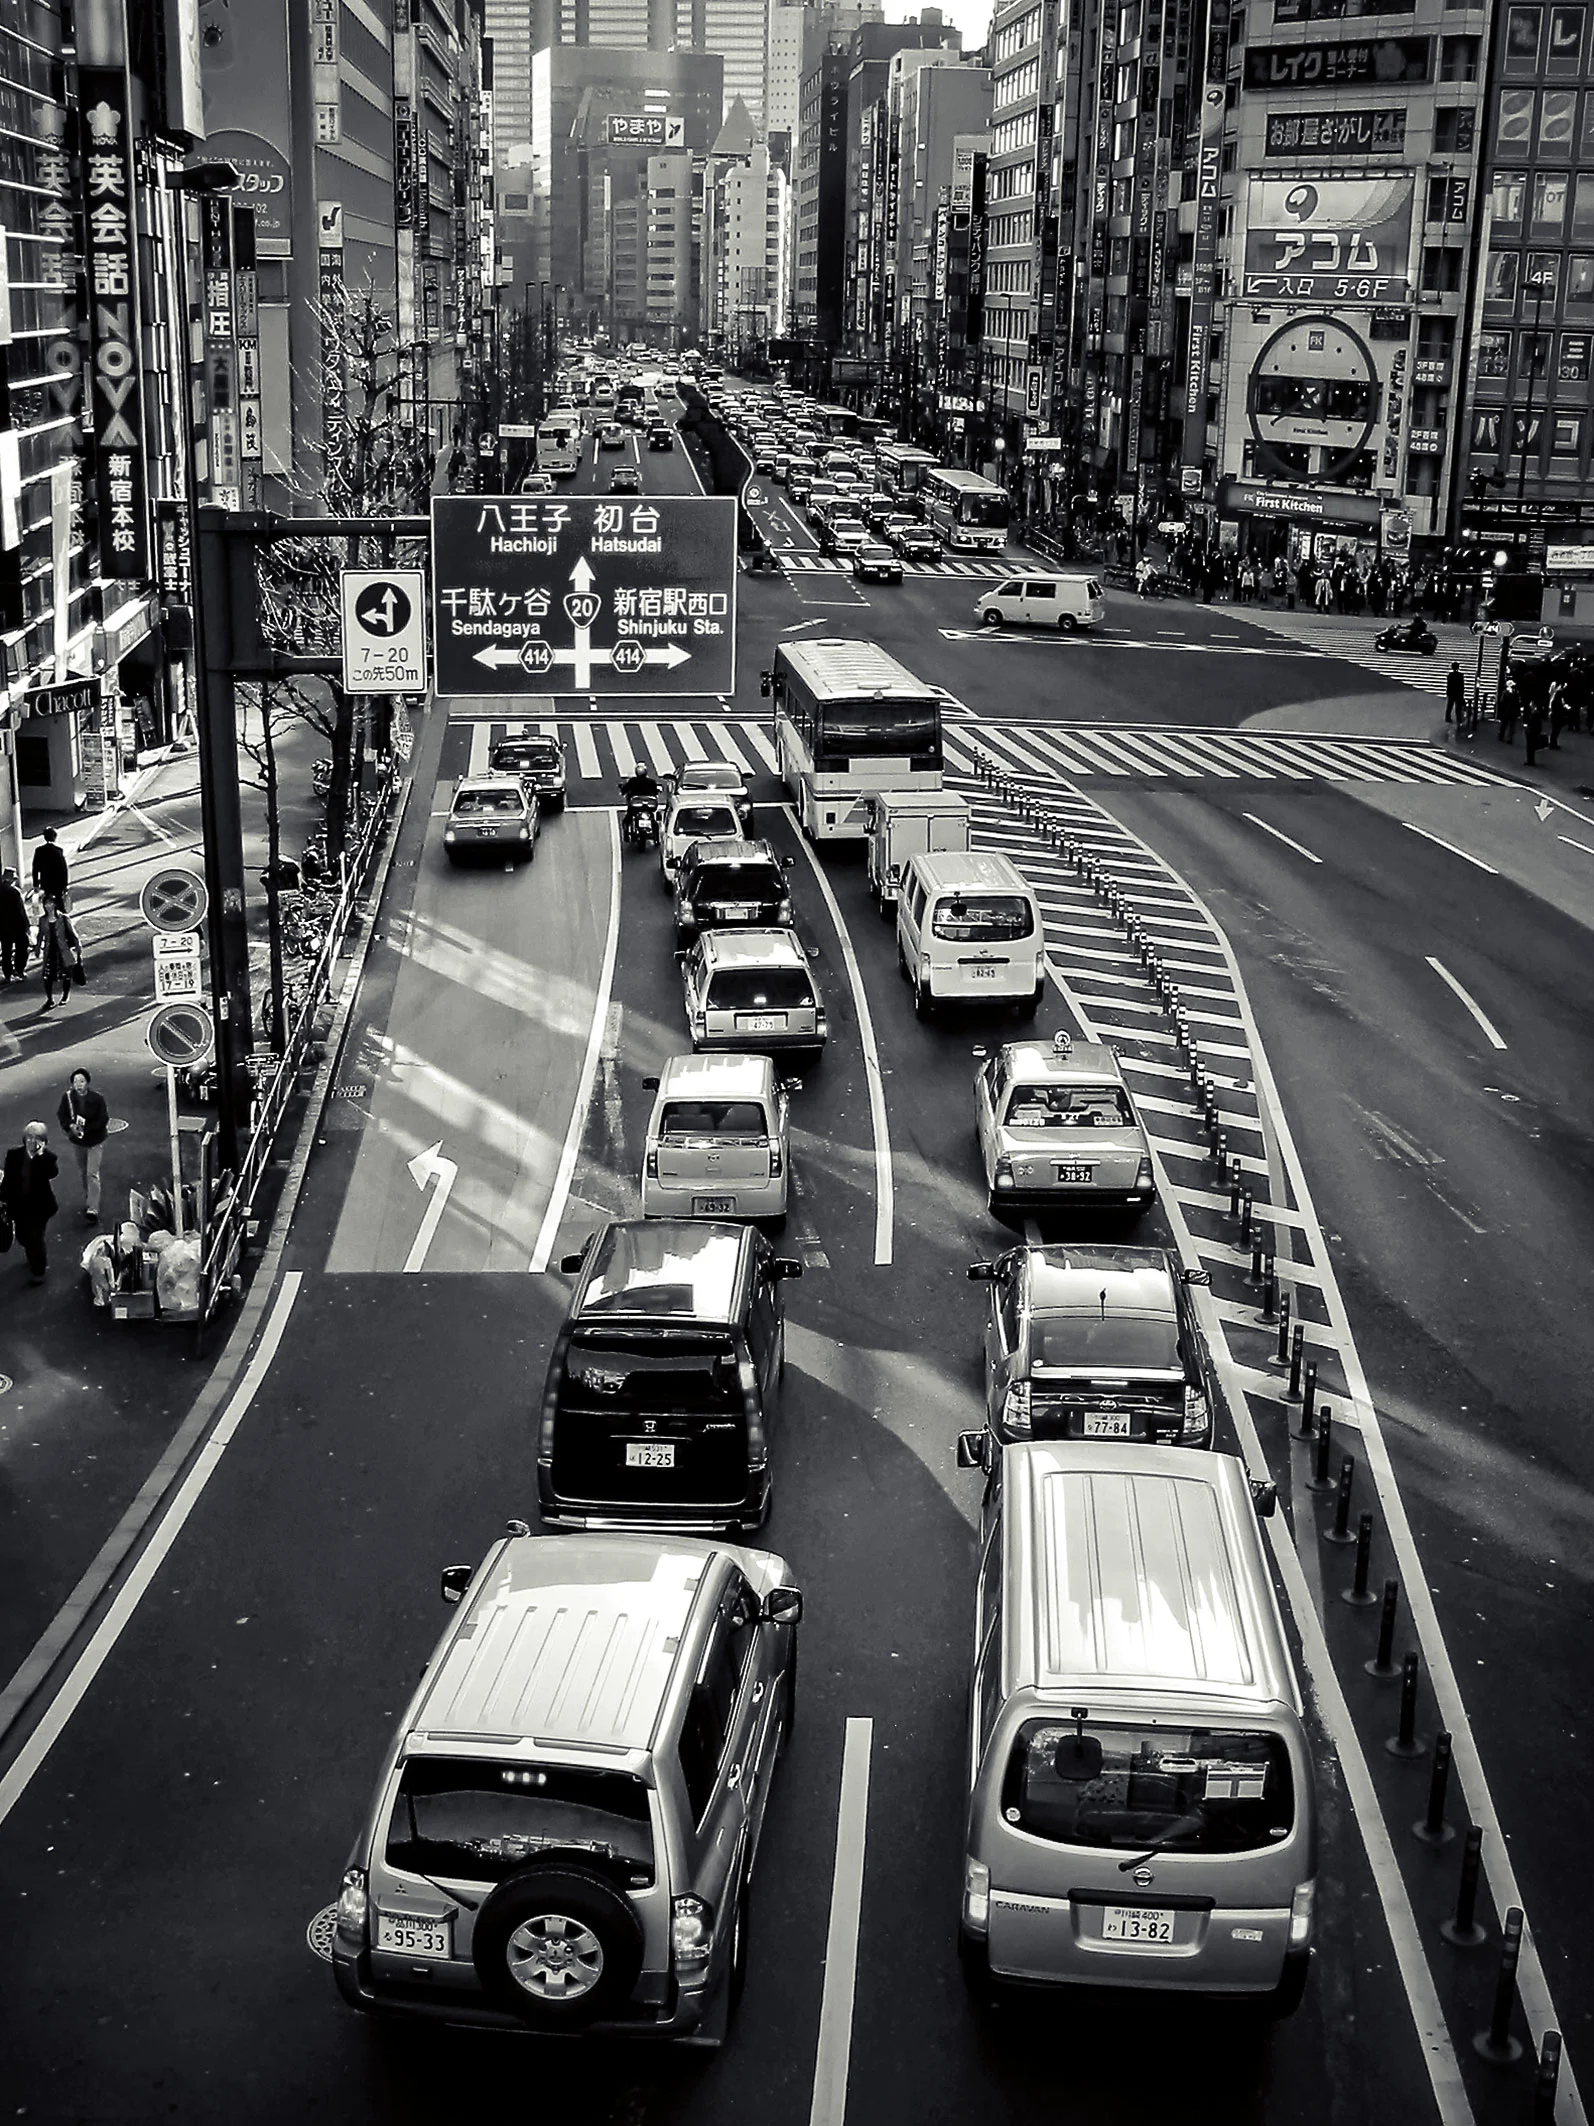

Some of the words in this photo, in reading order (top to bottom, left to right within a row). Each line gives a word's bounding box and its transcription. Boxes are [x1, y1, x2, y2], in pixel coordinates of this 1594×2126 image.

[1270, 51, 1322, 81] レイク
[612, 117, 662, 135] やまや
[1270, 117, 1370, 147] お部屋さがし
[1200, 147, 1219, 197] アコム
[1452, 181, 1467, 220] アコム
[88, 153, 129, 295] 英会話
[1275, 233, 1379, 270] アコム
[1278, 278, 1314, 295] 入口
[1531, 272, 1554, 284] 4F
[1191, 325, 1203, 357] First
[96, 302, 139, 446] NOVA
[1053, 347, 1065, 396] アイフル
[1186, 359, 1201, 413] Kitchen
[108, 453, 136, 552] 新宿本校
[1255, 496, 1281, 510] First
[1282, 499, 1323, 514] Kitchen
[477, 504, 571, 534] 八王子
[594, 505, 661, 534] 初台
[177, 504, 193, 604] キャッシュコーナー
[490, 536, 557, 554] Hachioji
[590, 536, 662, 553] Hatsudai
[571, 599, 593, 617] 20
[613, 588, 728, 617] 新宿駅西口
[451, 619, 541, 639] Sendagaya
[617, 619, 688, 637] Shinjuku
[693, 619, 725, 636] Sta.
[523, 649, 549, 663] 414
[615, 649, 641, 663] 414
[352, 666, 419, 682] この先50m
[35, 688, 92, 717] Chacott
[1095, 1421, 1128, 1435] 77-84
[638, 1452, 672, 1466] 12-25
[995, 1900, 1051, 1914] CARAVAN
[394, 1929, 446, 1952] 95-33
[1120, 1920, 1171, 1940] 13-82
